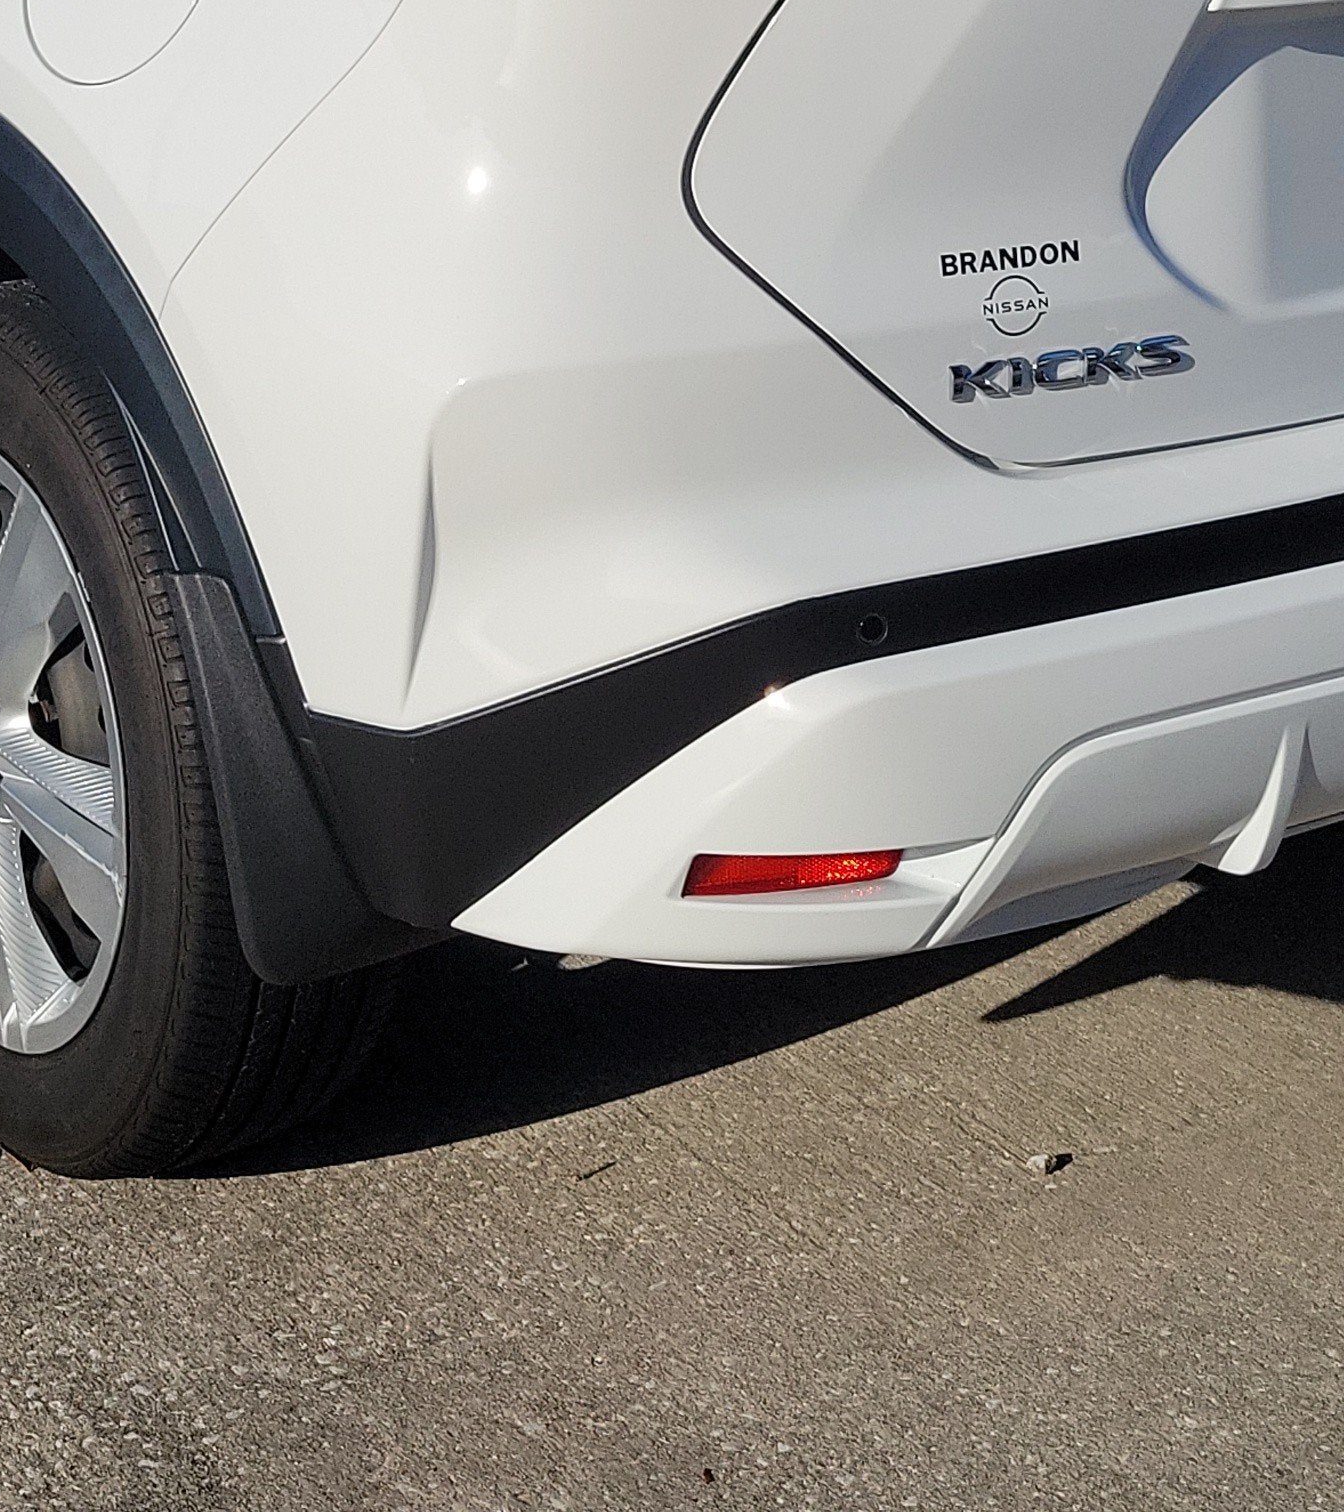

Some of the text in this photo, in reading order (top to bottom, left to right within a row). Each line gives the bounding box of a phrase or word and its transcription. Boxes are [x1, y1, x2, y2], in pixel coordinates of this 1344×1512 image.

[940, 240, 1080, 277] BRANDON
[983, 297, 1049, 315] NISSAN
[949, 334, 1196, 403] KICKS
